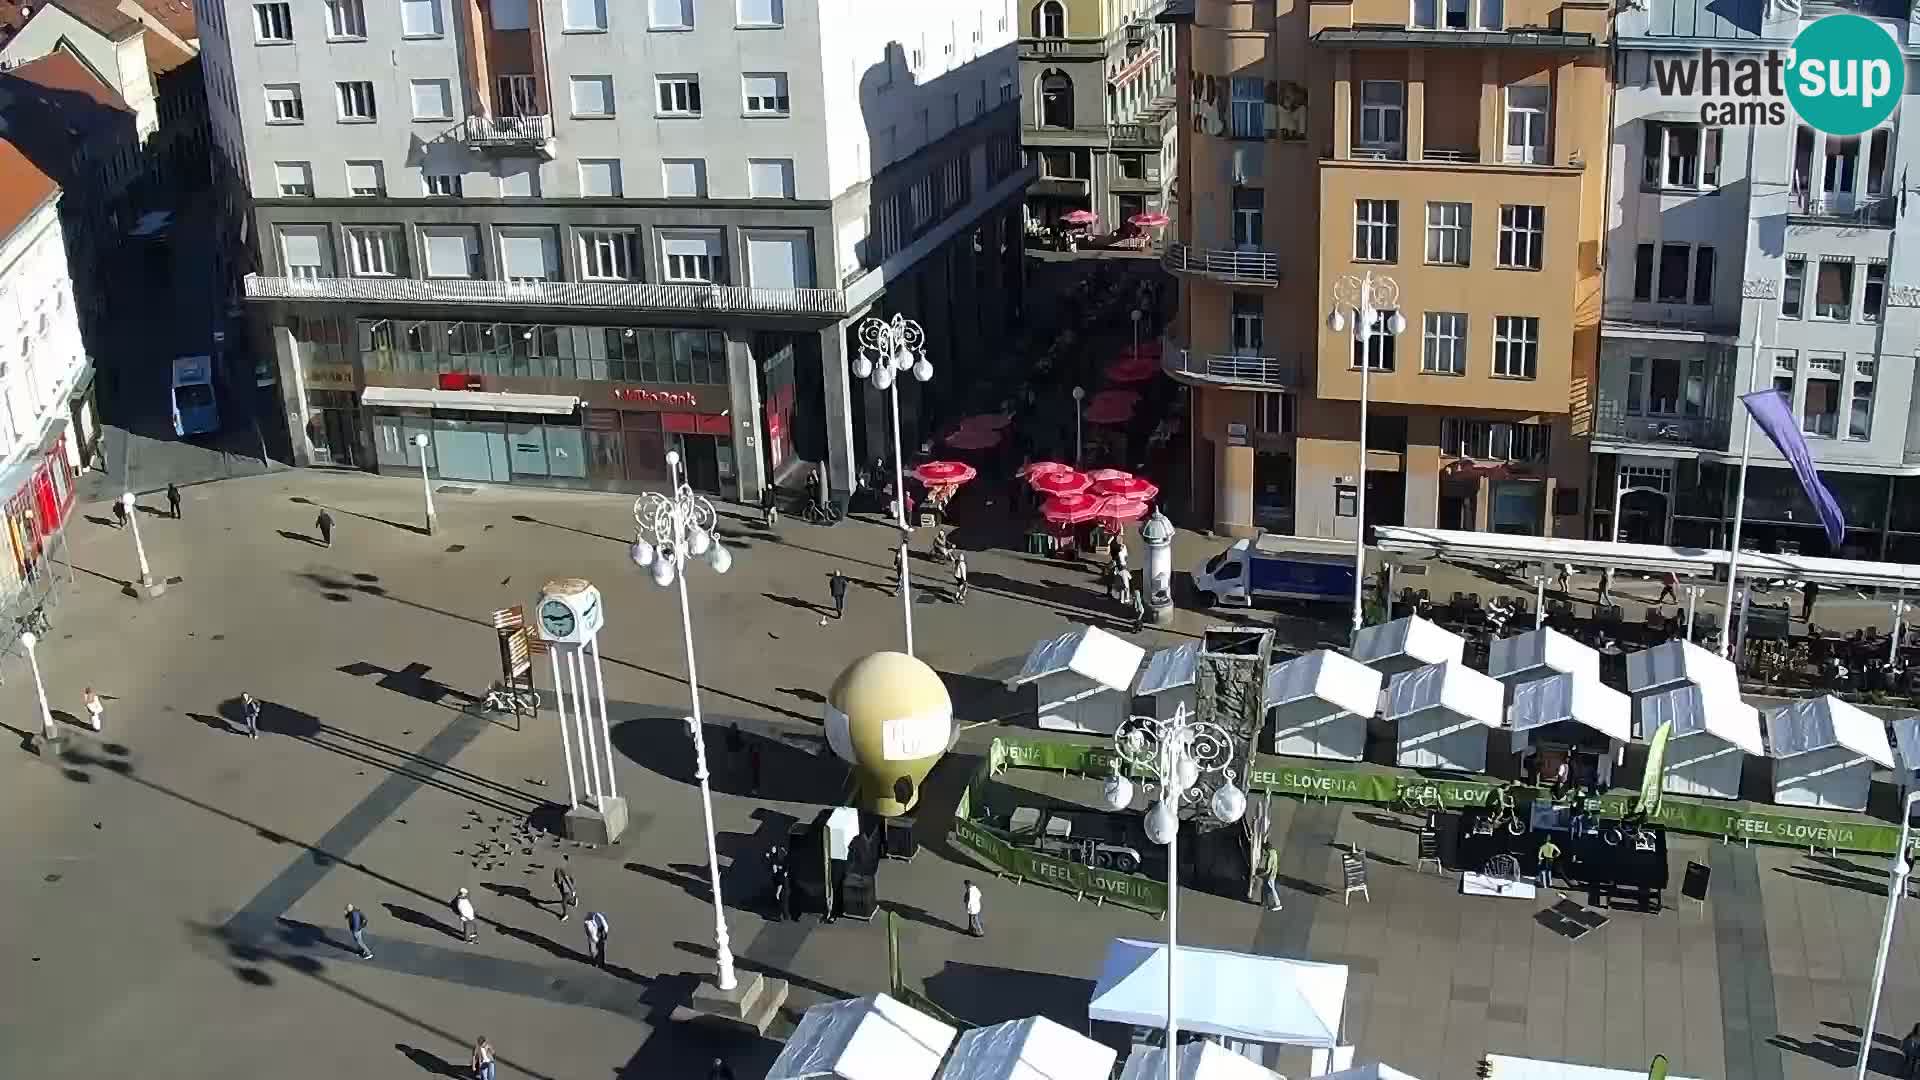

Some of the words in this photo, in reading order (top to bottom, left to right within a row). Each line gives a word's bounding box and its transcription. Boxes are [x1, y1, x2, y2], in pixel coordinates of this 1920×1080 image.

[1283, 773, 1358, 793] SLOVENIA
[1737, 819, 1773, 834] FEEL
[1777, 823, 1854, 842] SLOVENIA
[1040, 862, 1072, 881] FEEL
